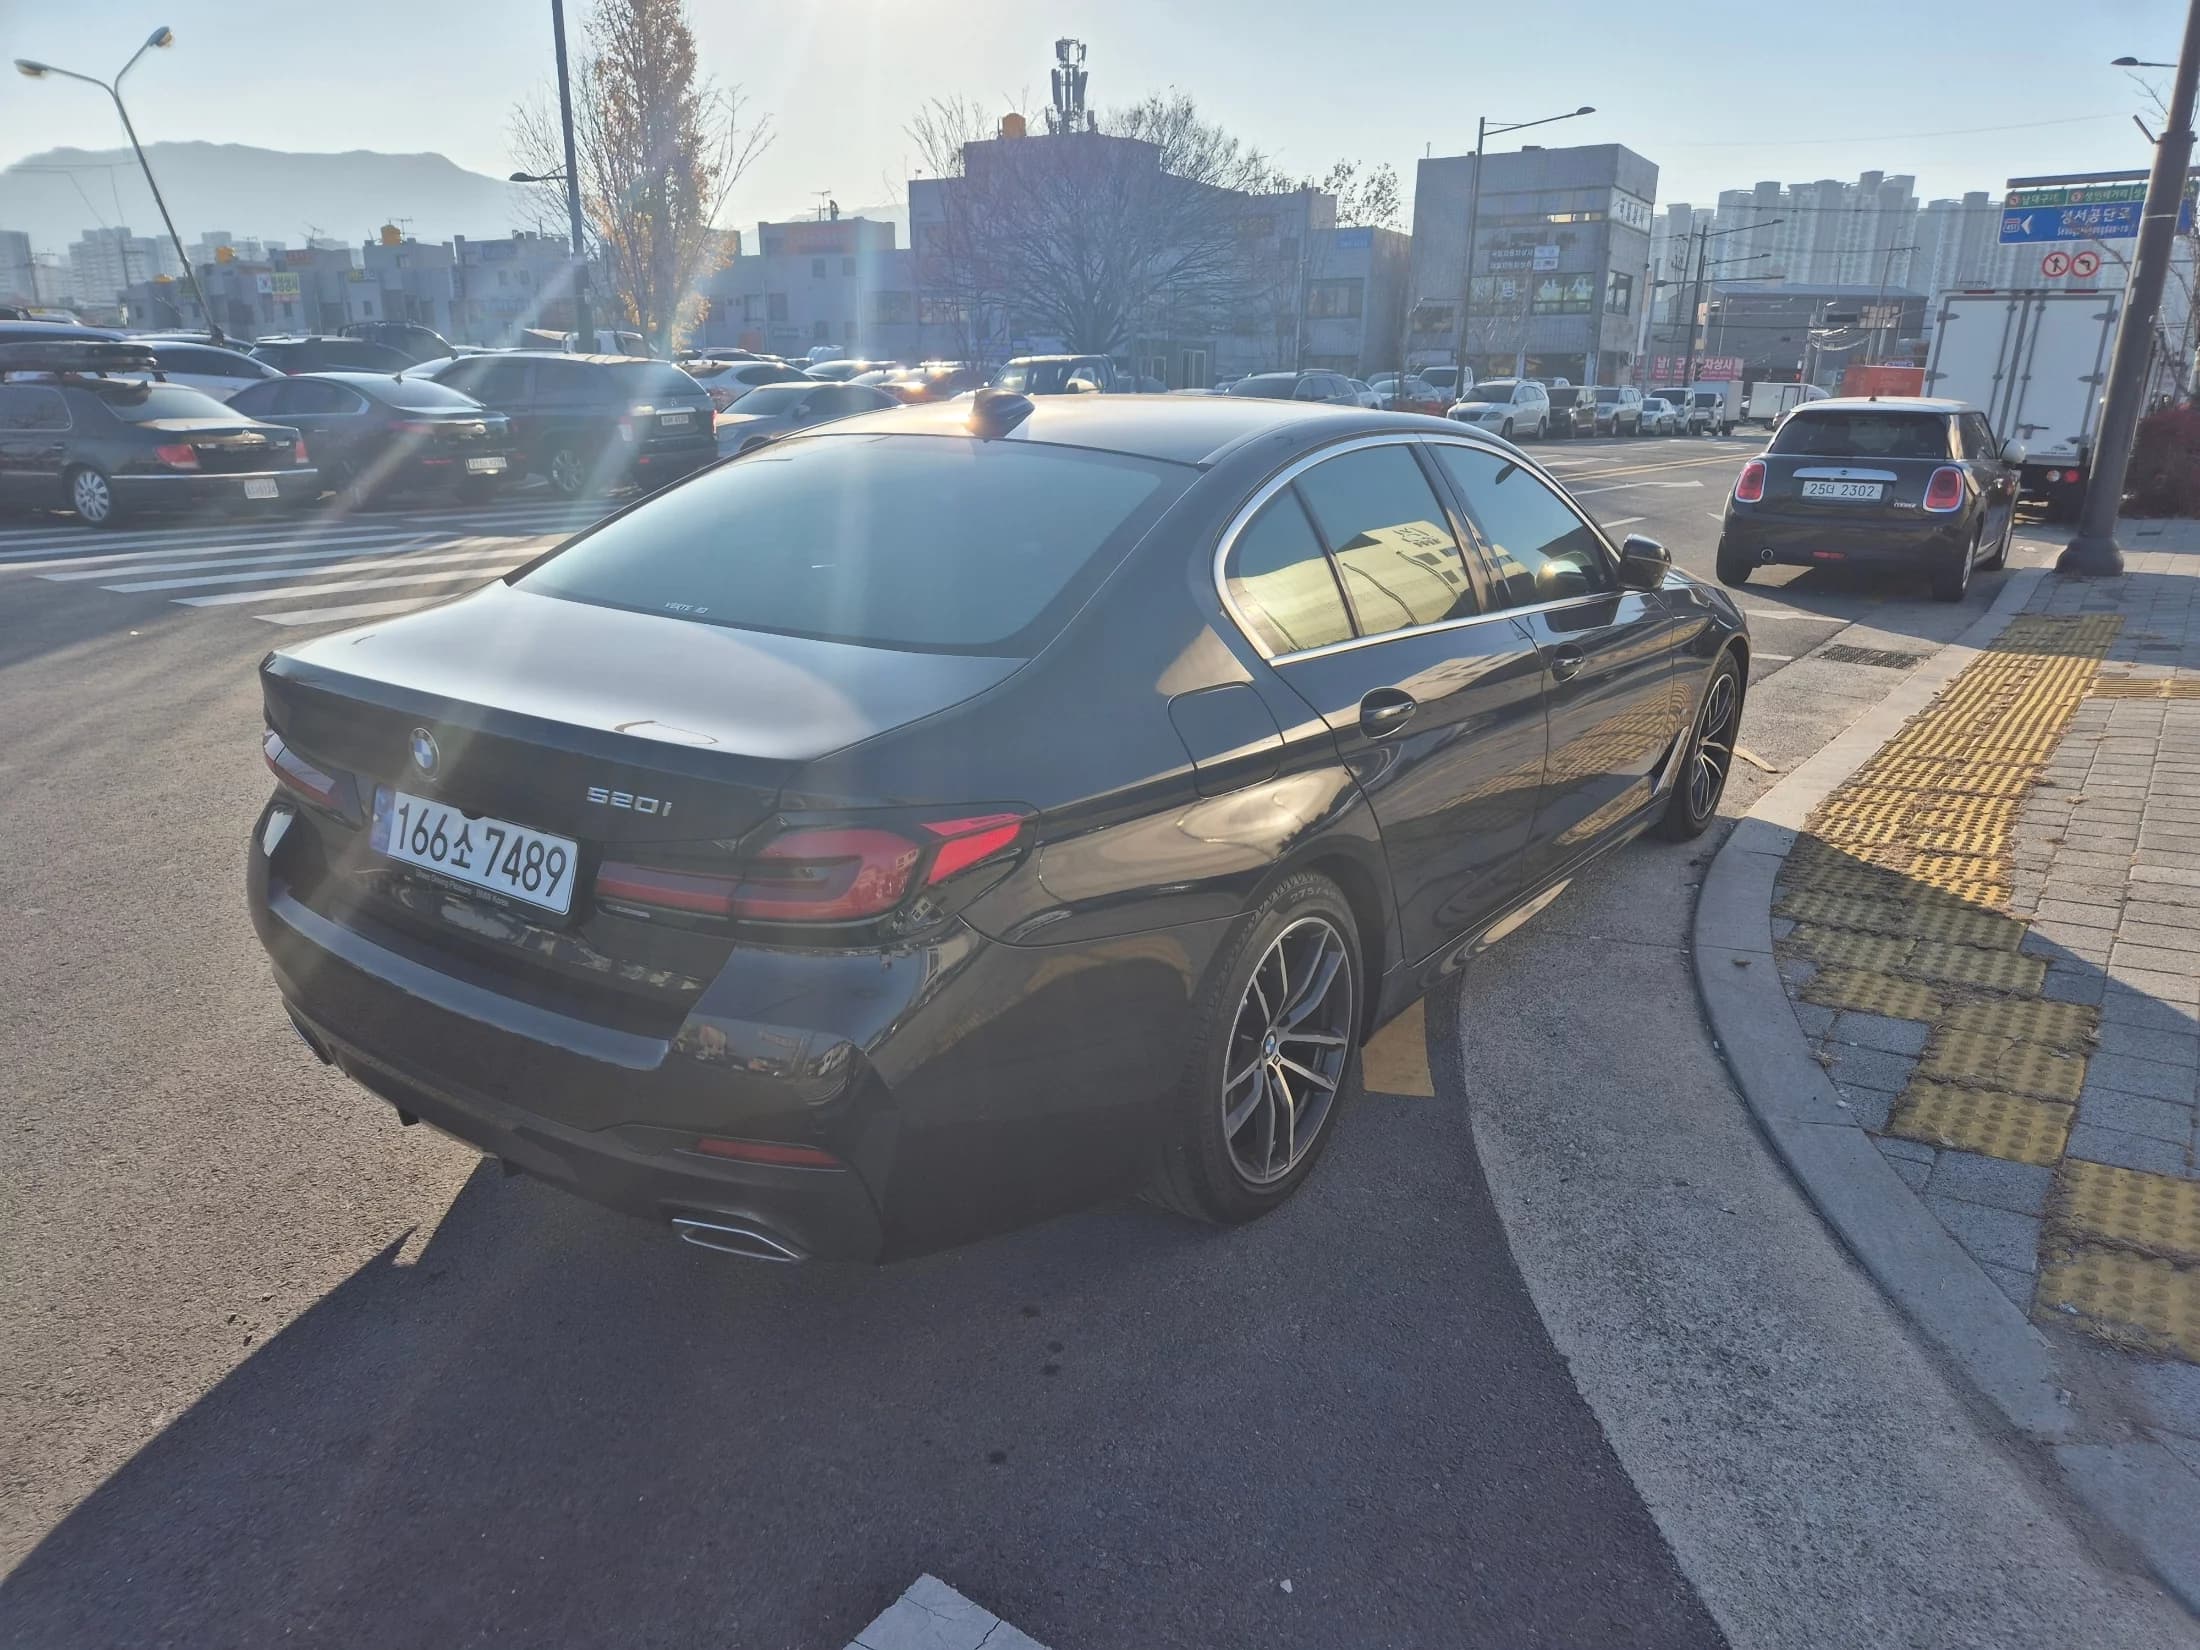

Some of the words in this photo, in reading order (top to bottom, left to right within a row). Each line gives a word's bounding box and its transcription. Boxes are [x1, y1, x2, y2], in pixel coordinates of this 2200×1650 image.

[2061, 206, 2131, 225] 성서공단로
[1840, 484, 1875, 497] 2302
[586, 786, 673, 817] 520i
[398, 802, 567, 897] 166소7489
